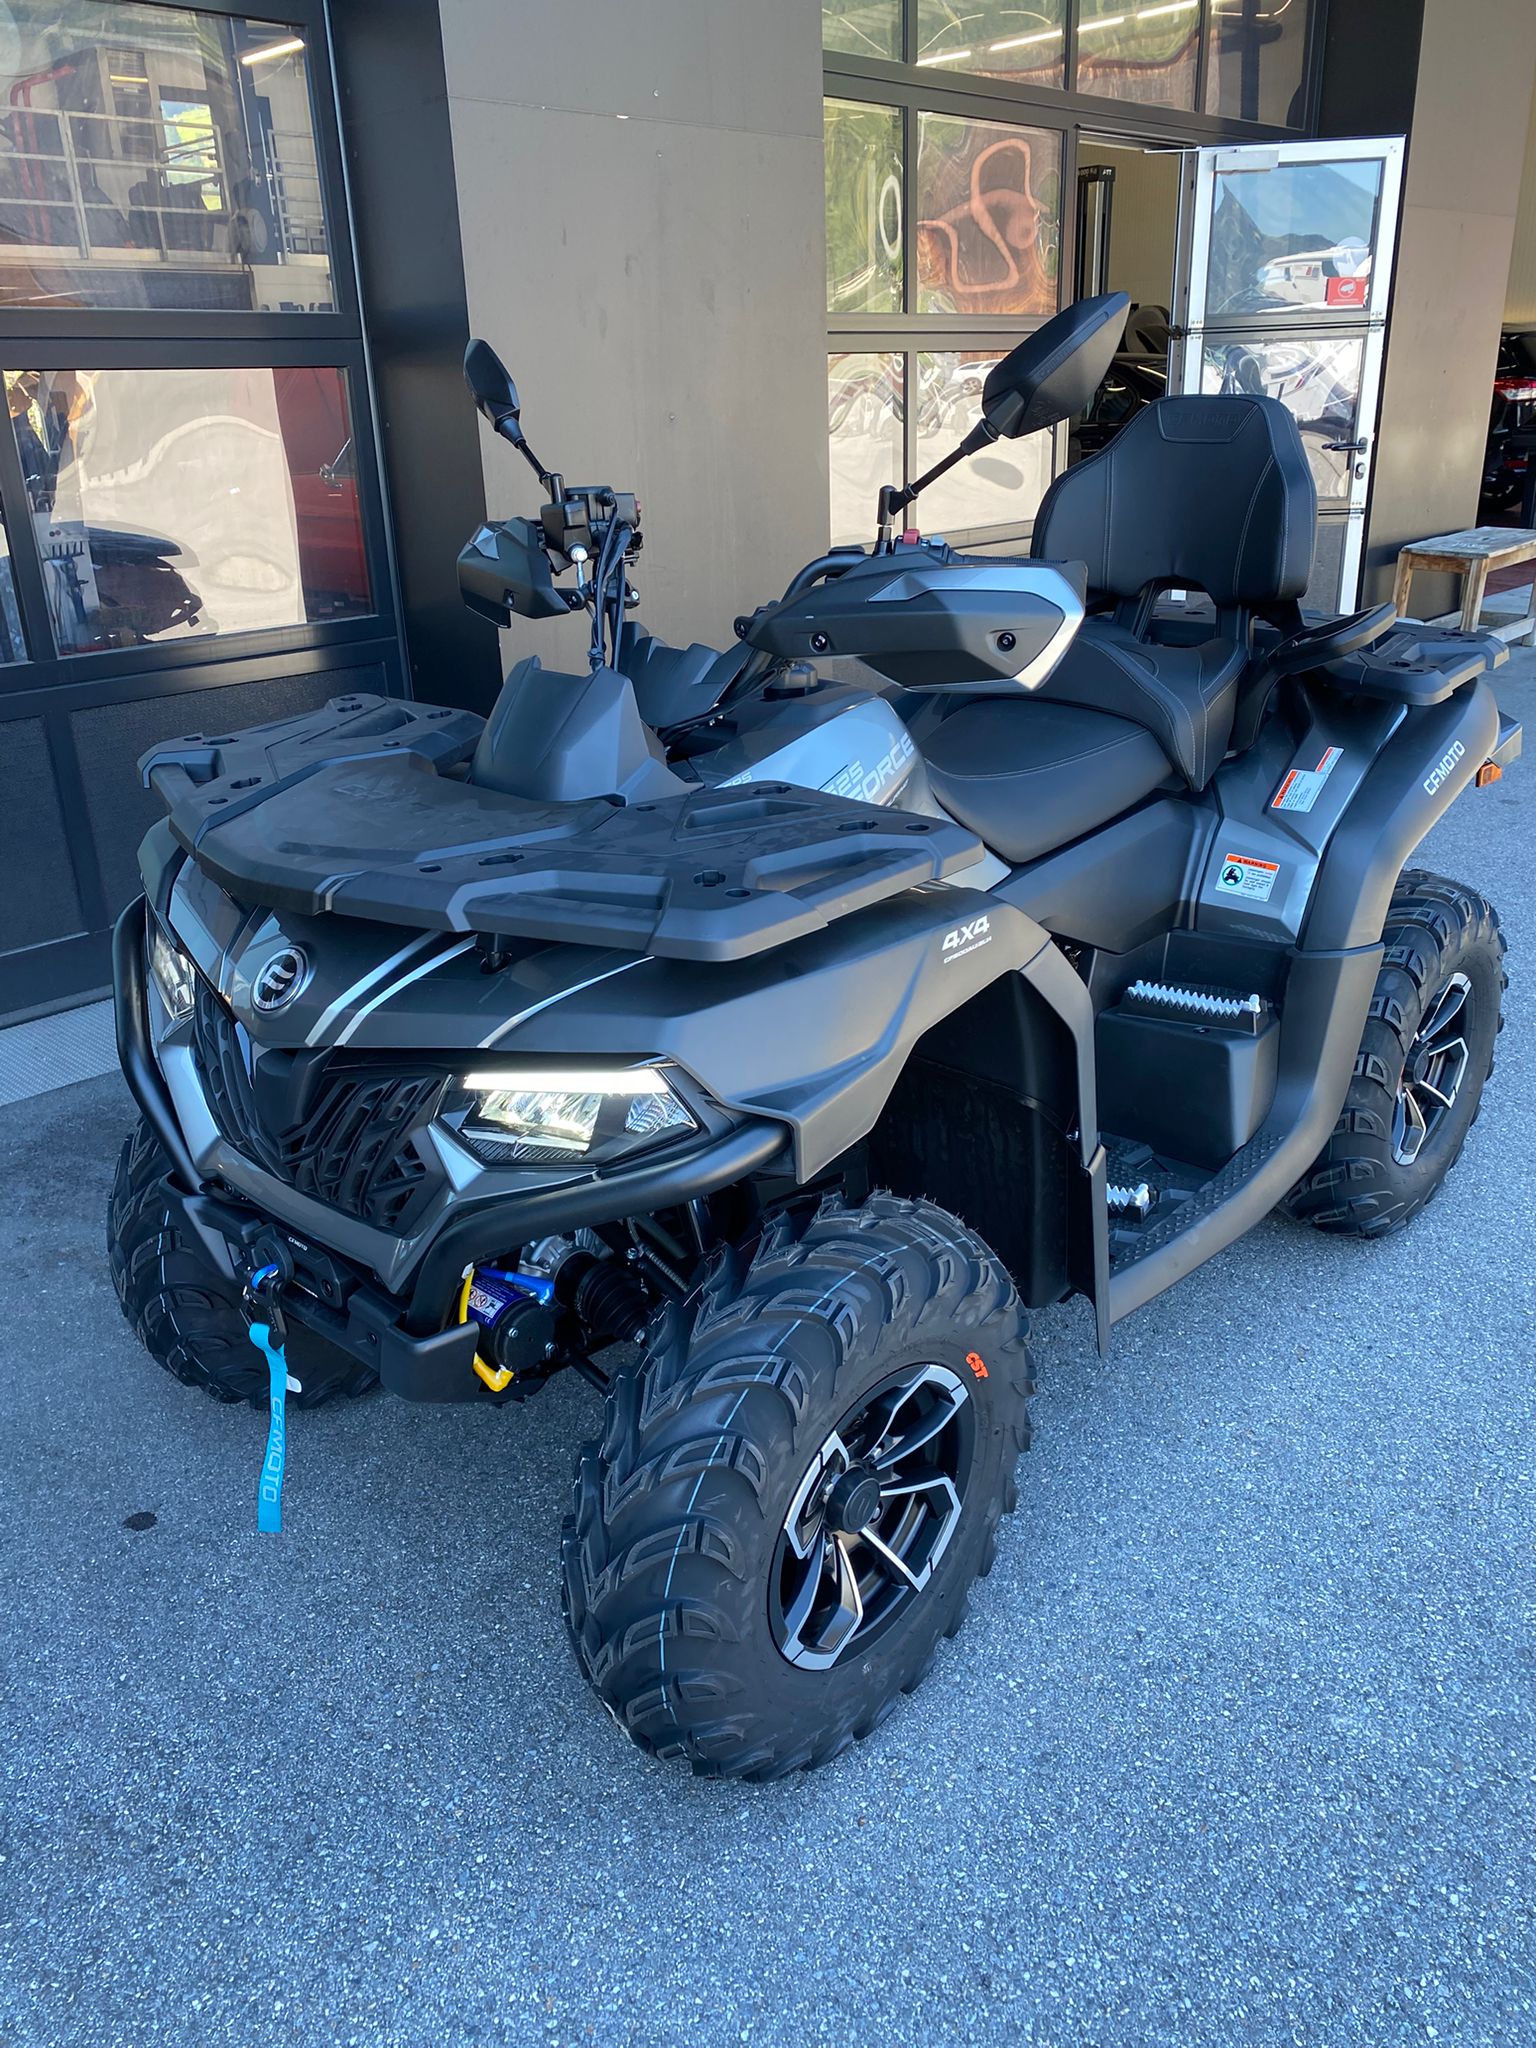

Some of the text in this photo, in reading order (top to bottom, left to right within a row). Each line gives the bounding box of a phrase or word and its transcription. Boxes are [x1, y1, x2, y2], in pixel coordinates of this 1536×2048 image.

[1423, 740, 1466, 796] CFMOTO
[942, 915, 990, 951] 4X4
[288, 1236, 308, 1251] CFMOTO
[966, 1352, 989, 1378] CST
[262, 1396, 283, 1503] CFMOTO
